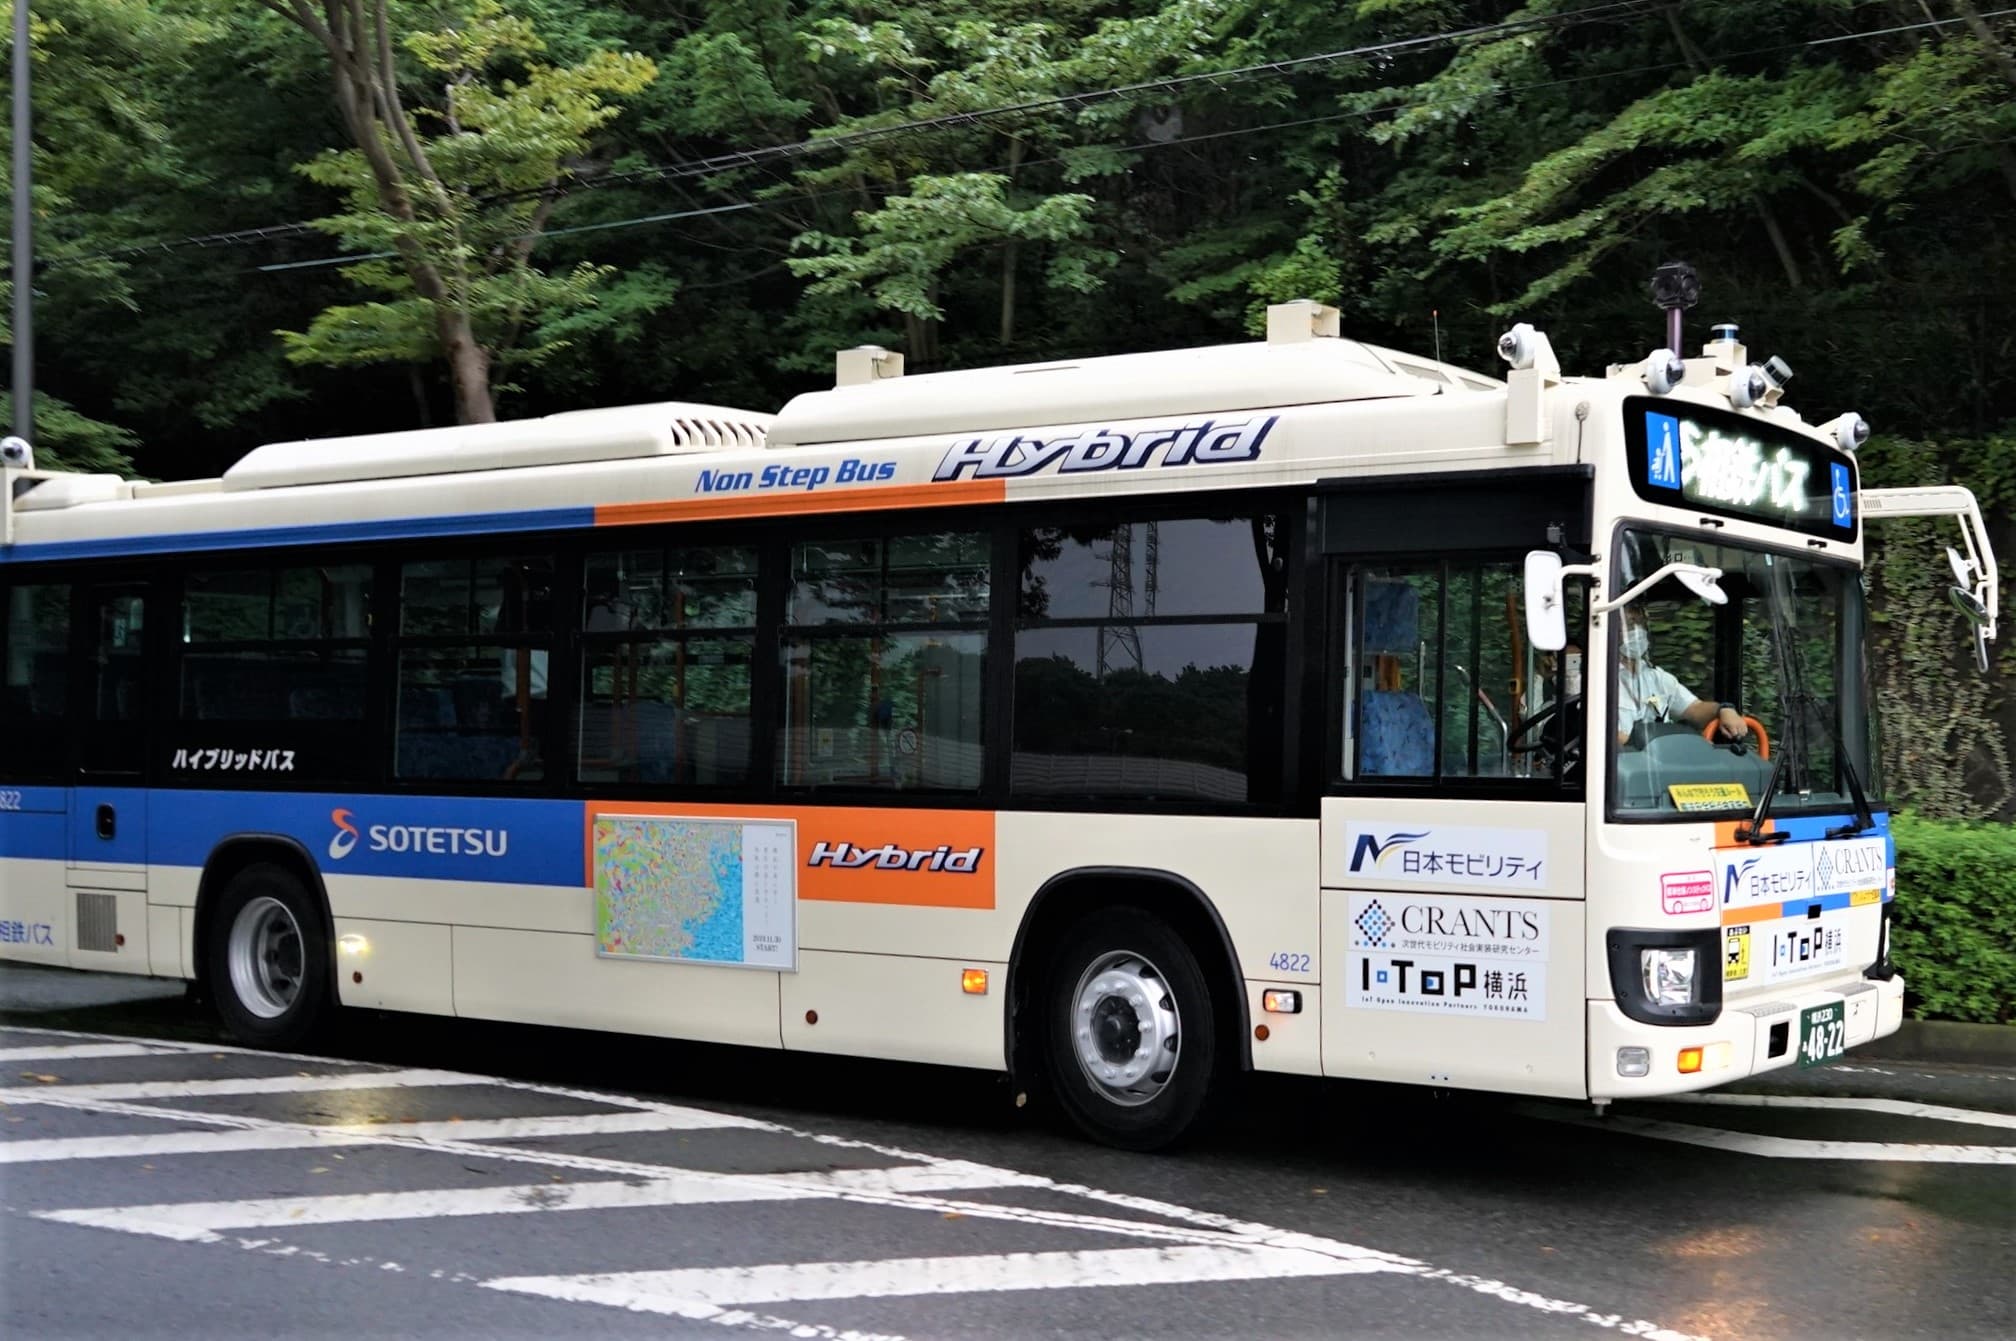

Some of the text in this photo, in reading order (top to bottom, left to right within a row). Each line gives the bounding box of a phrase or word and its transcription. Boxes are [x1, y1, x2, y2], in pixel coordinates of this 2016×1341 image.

[931, 414, 1280, 482] Hybrid
[695, 459, 896, 492] Non Step Bus
[172, 749, 295, 770] ハイブリッドバス
[369, 825, 507, 856] SOTETSU
[807, 841, 984, 873] Hybrid
[1403, 850, 1543, 880] 日本モビリティ
[1834, 845, 1883, 876] CRANTS
[1401, 904, 1540, 941] CRANTS
[1269, 952, 1310, 972] 4822
